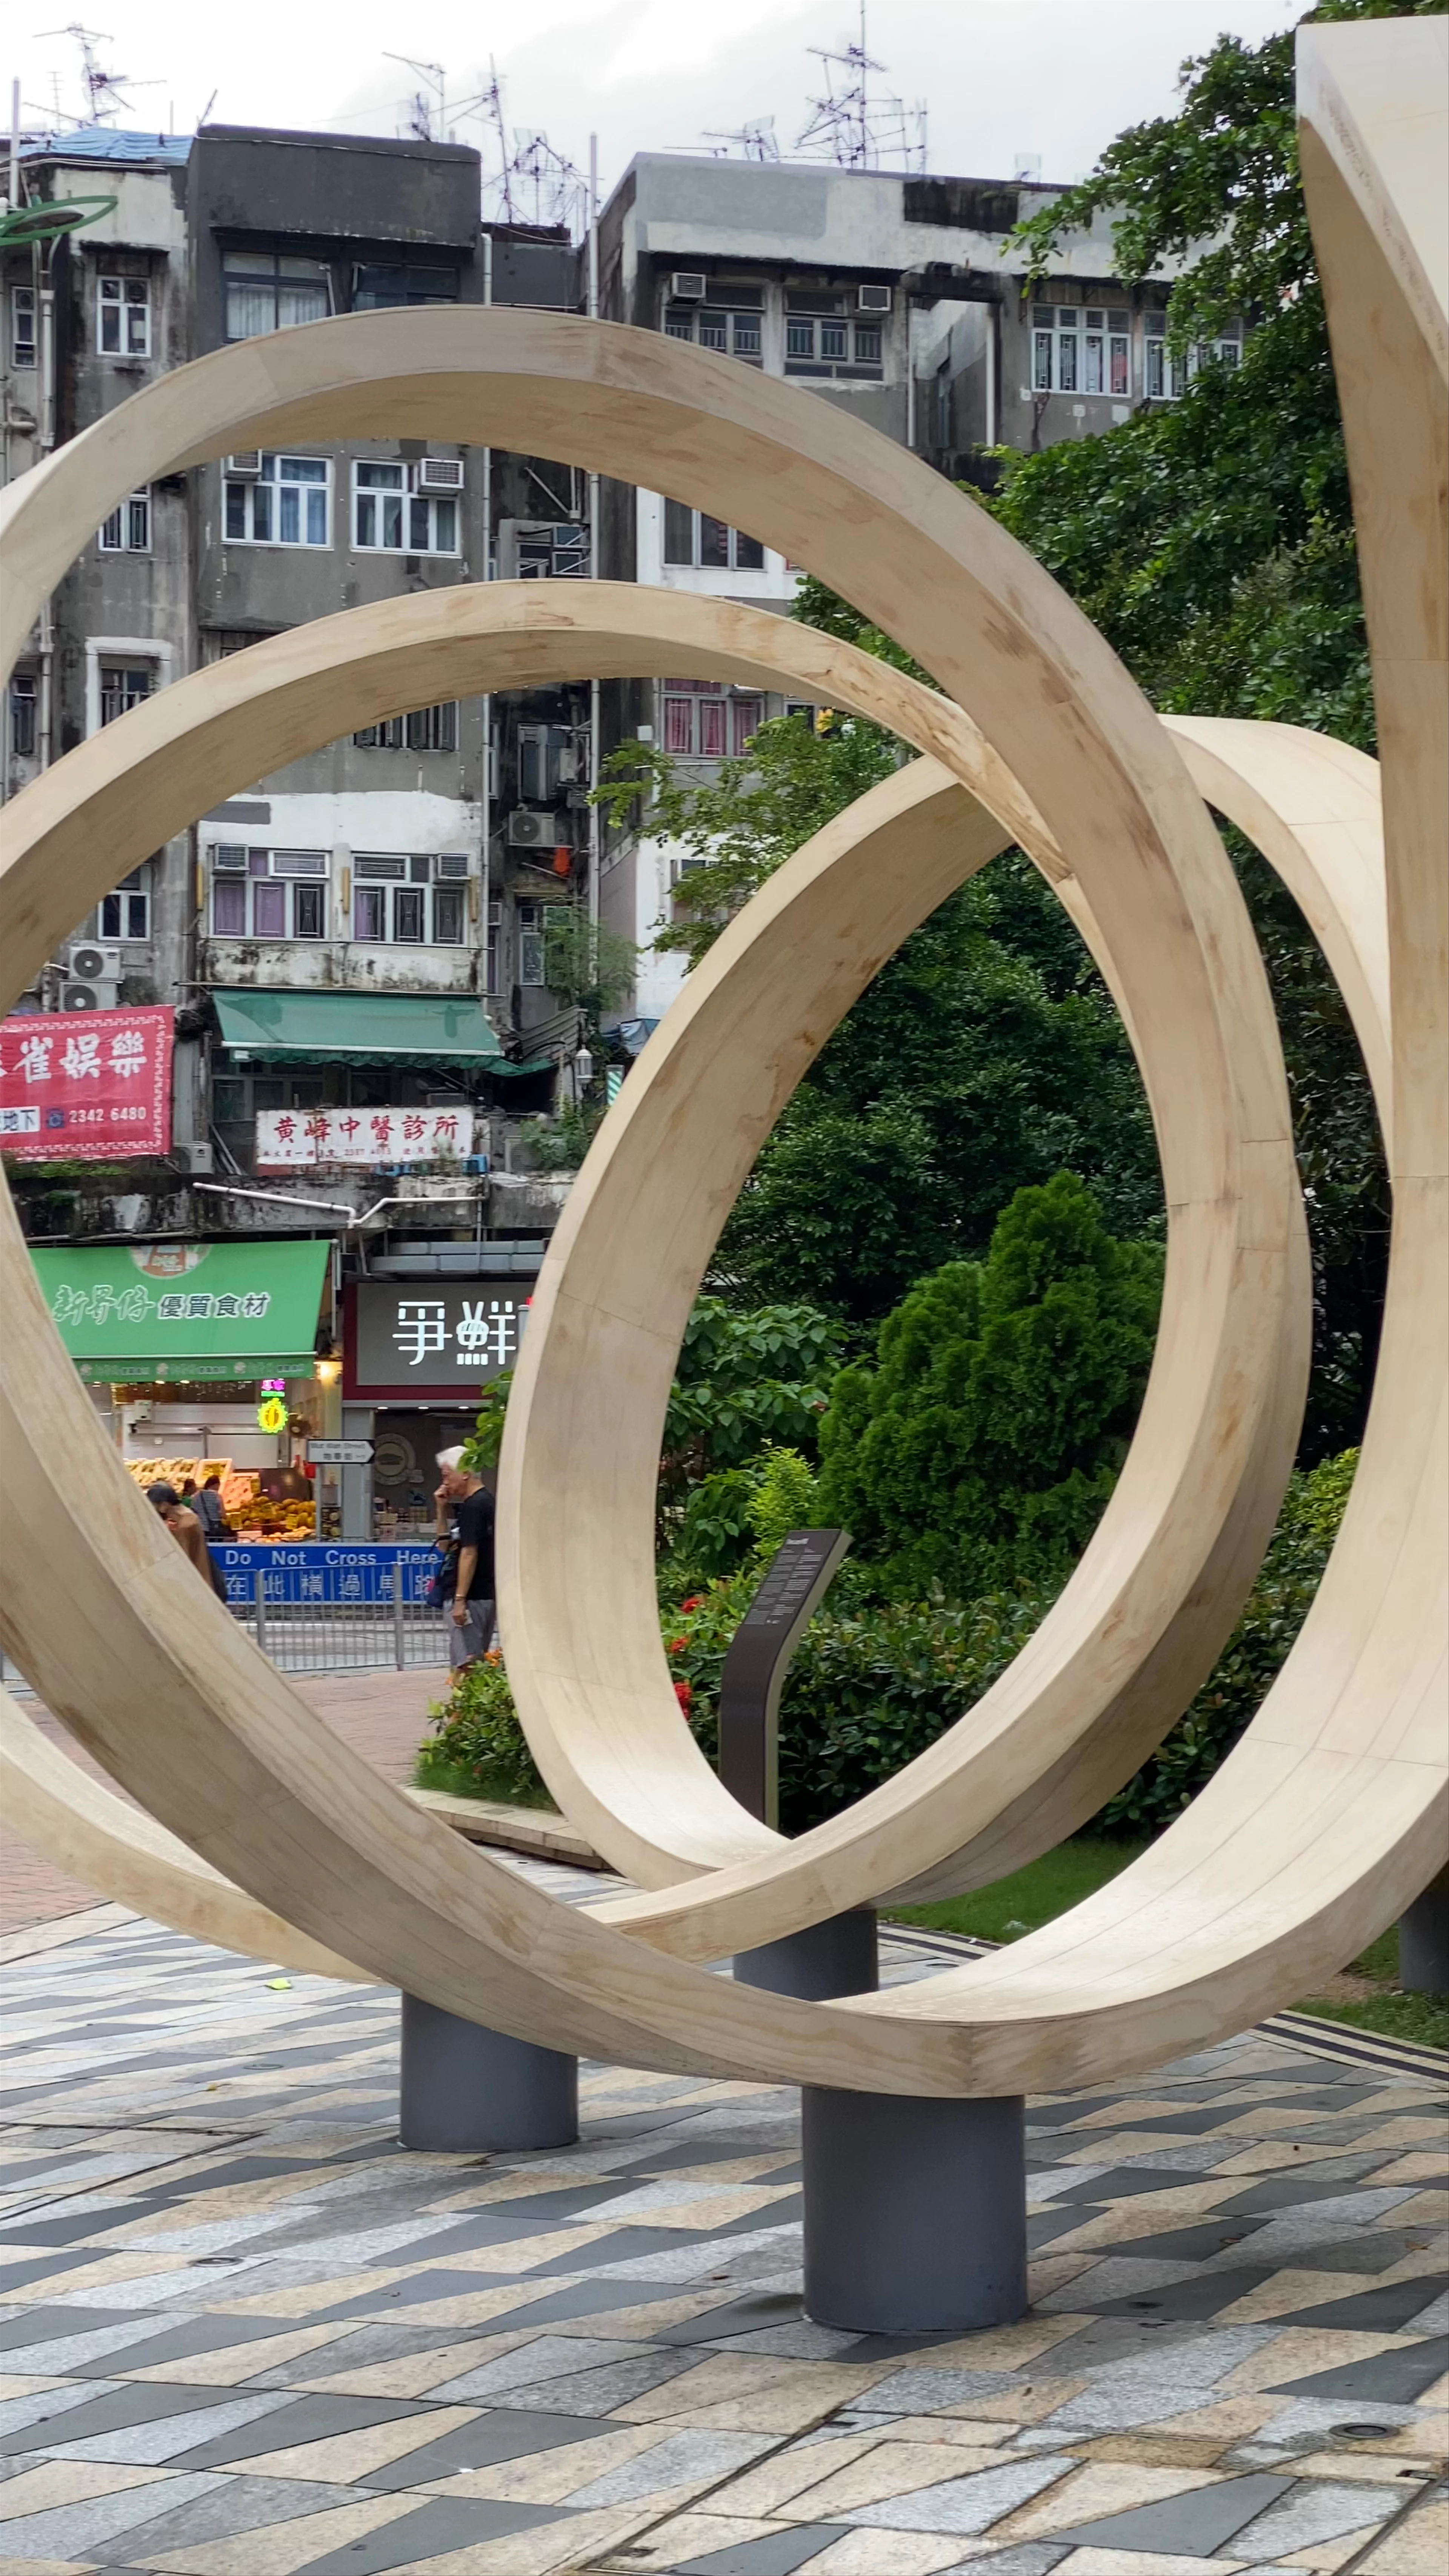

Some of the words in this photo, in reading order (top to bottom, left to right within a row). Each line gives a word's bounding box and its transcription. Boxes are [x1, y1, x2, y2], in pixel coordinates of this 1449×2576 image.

[0, 1030, 147, 1084] 雀娛樂
[69, 1109, 104, 1123] 2342
[110, 1107, 146, 1121] 6480
[225, 1550, 251, 1565] Do
[271, 1550, 307, 1565] Not
[325, 1550, 377, 1565] Cross
[396, 1550, 438, 1564] Here
